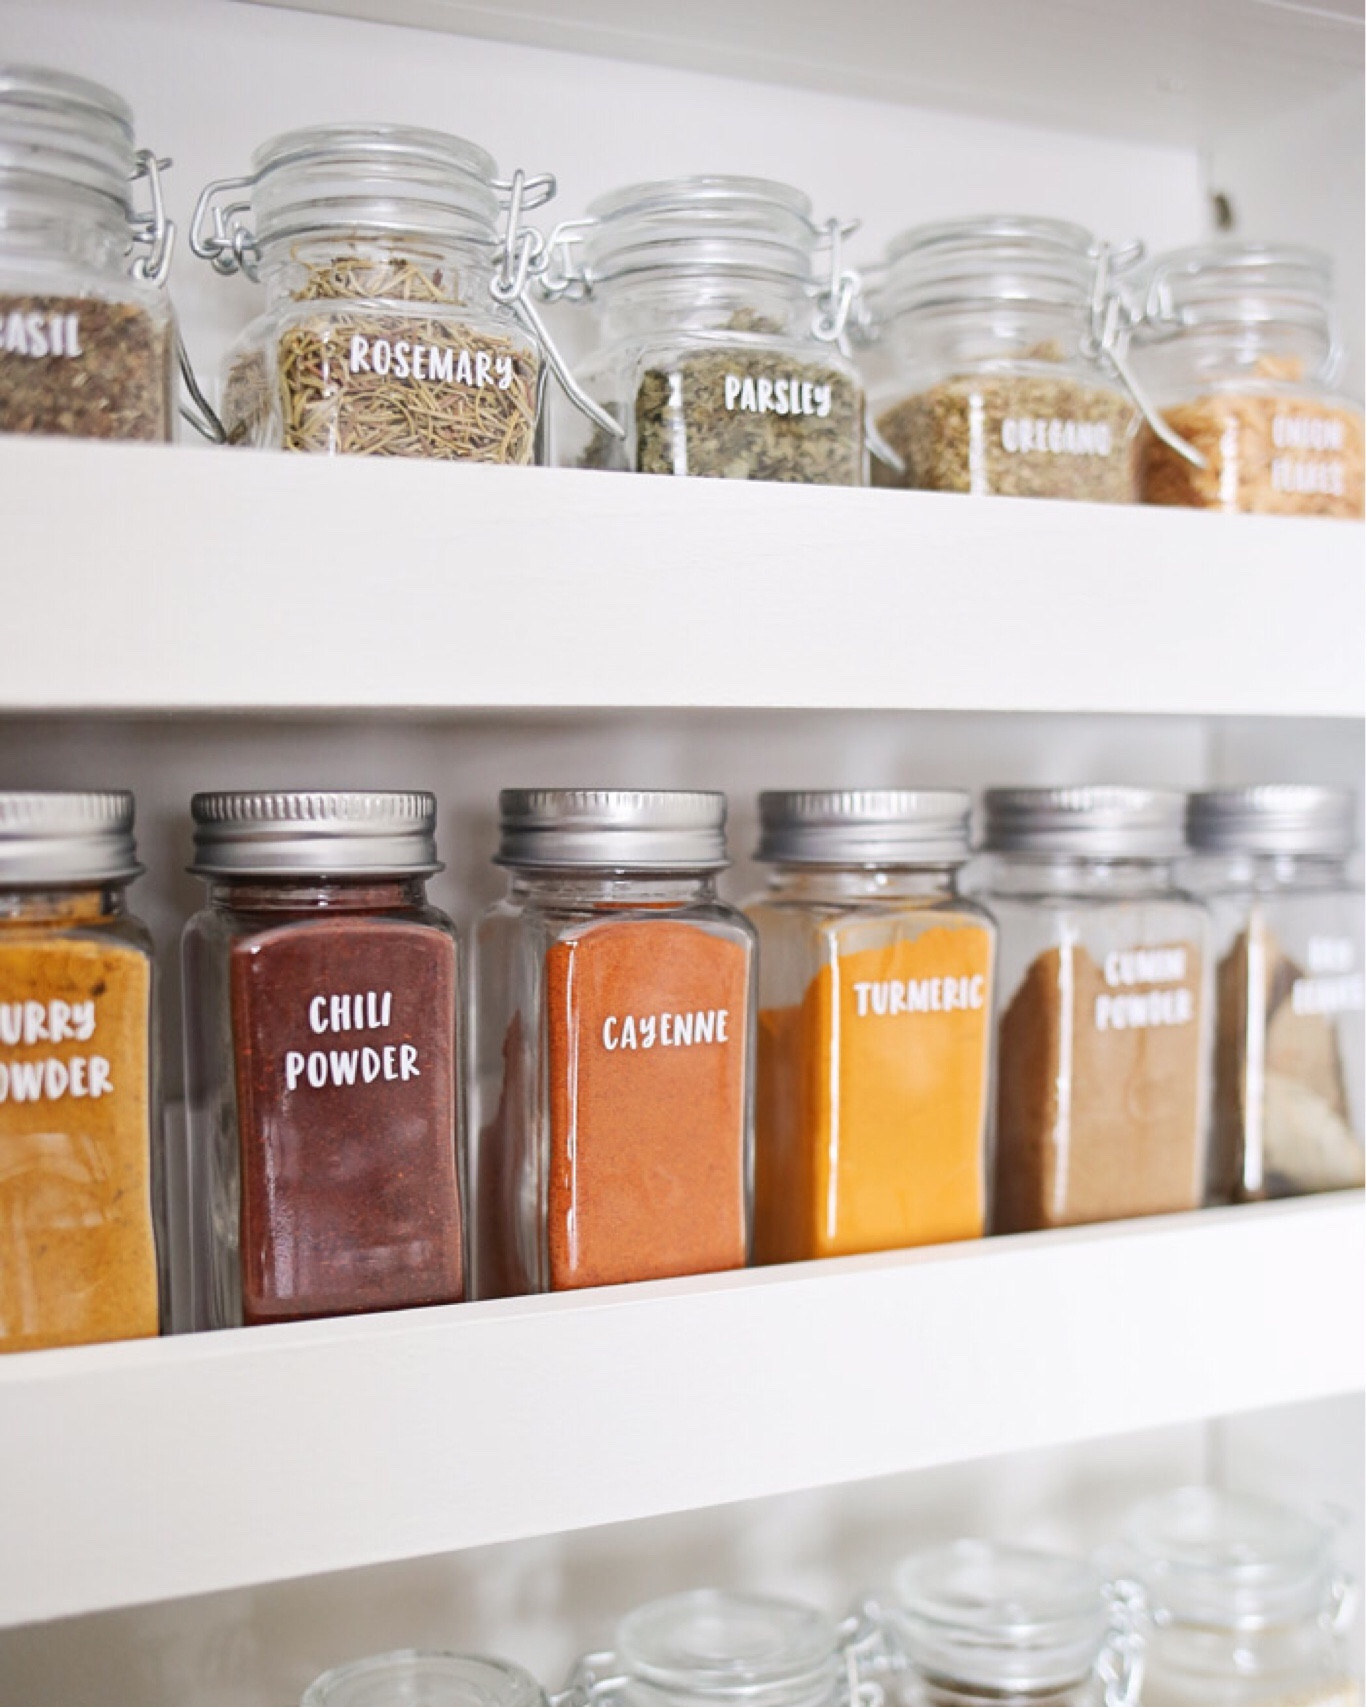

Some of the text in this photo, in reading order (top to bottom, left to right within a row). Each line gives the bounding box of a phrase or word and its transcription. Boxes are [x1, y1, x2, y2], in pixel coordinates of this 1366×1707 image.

[0, 310, 82, 357] ASIL
[350, 334, 513, 390] ROSEMARY
[724, 375, 832, 417] PARSLEY
[1002, 418, 1111, 456] OREGANO
[309, 990, 392, 1034] CHILI
[852, 974, 983, 1017] TURMERIC
[0, 999, 96, 1045] URRY
[602, 1008, 729, 1051] CAYENNE
[0, 1055, 114, 1102] WDER
[284, 1043, 421, 1091] POWDER
